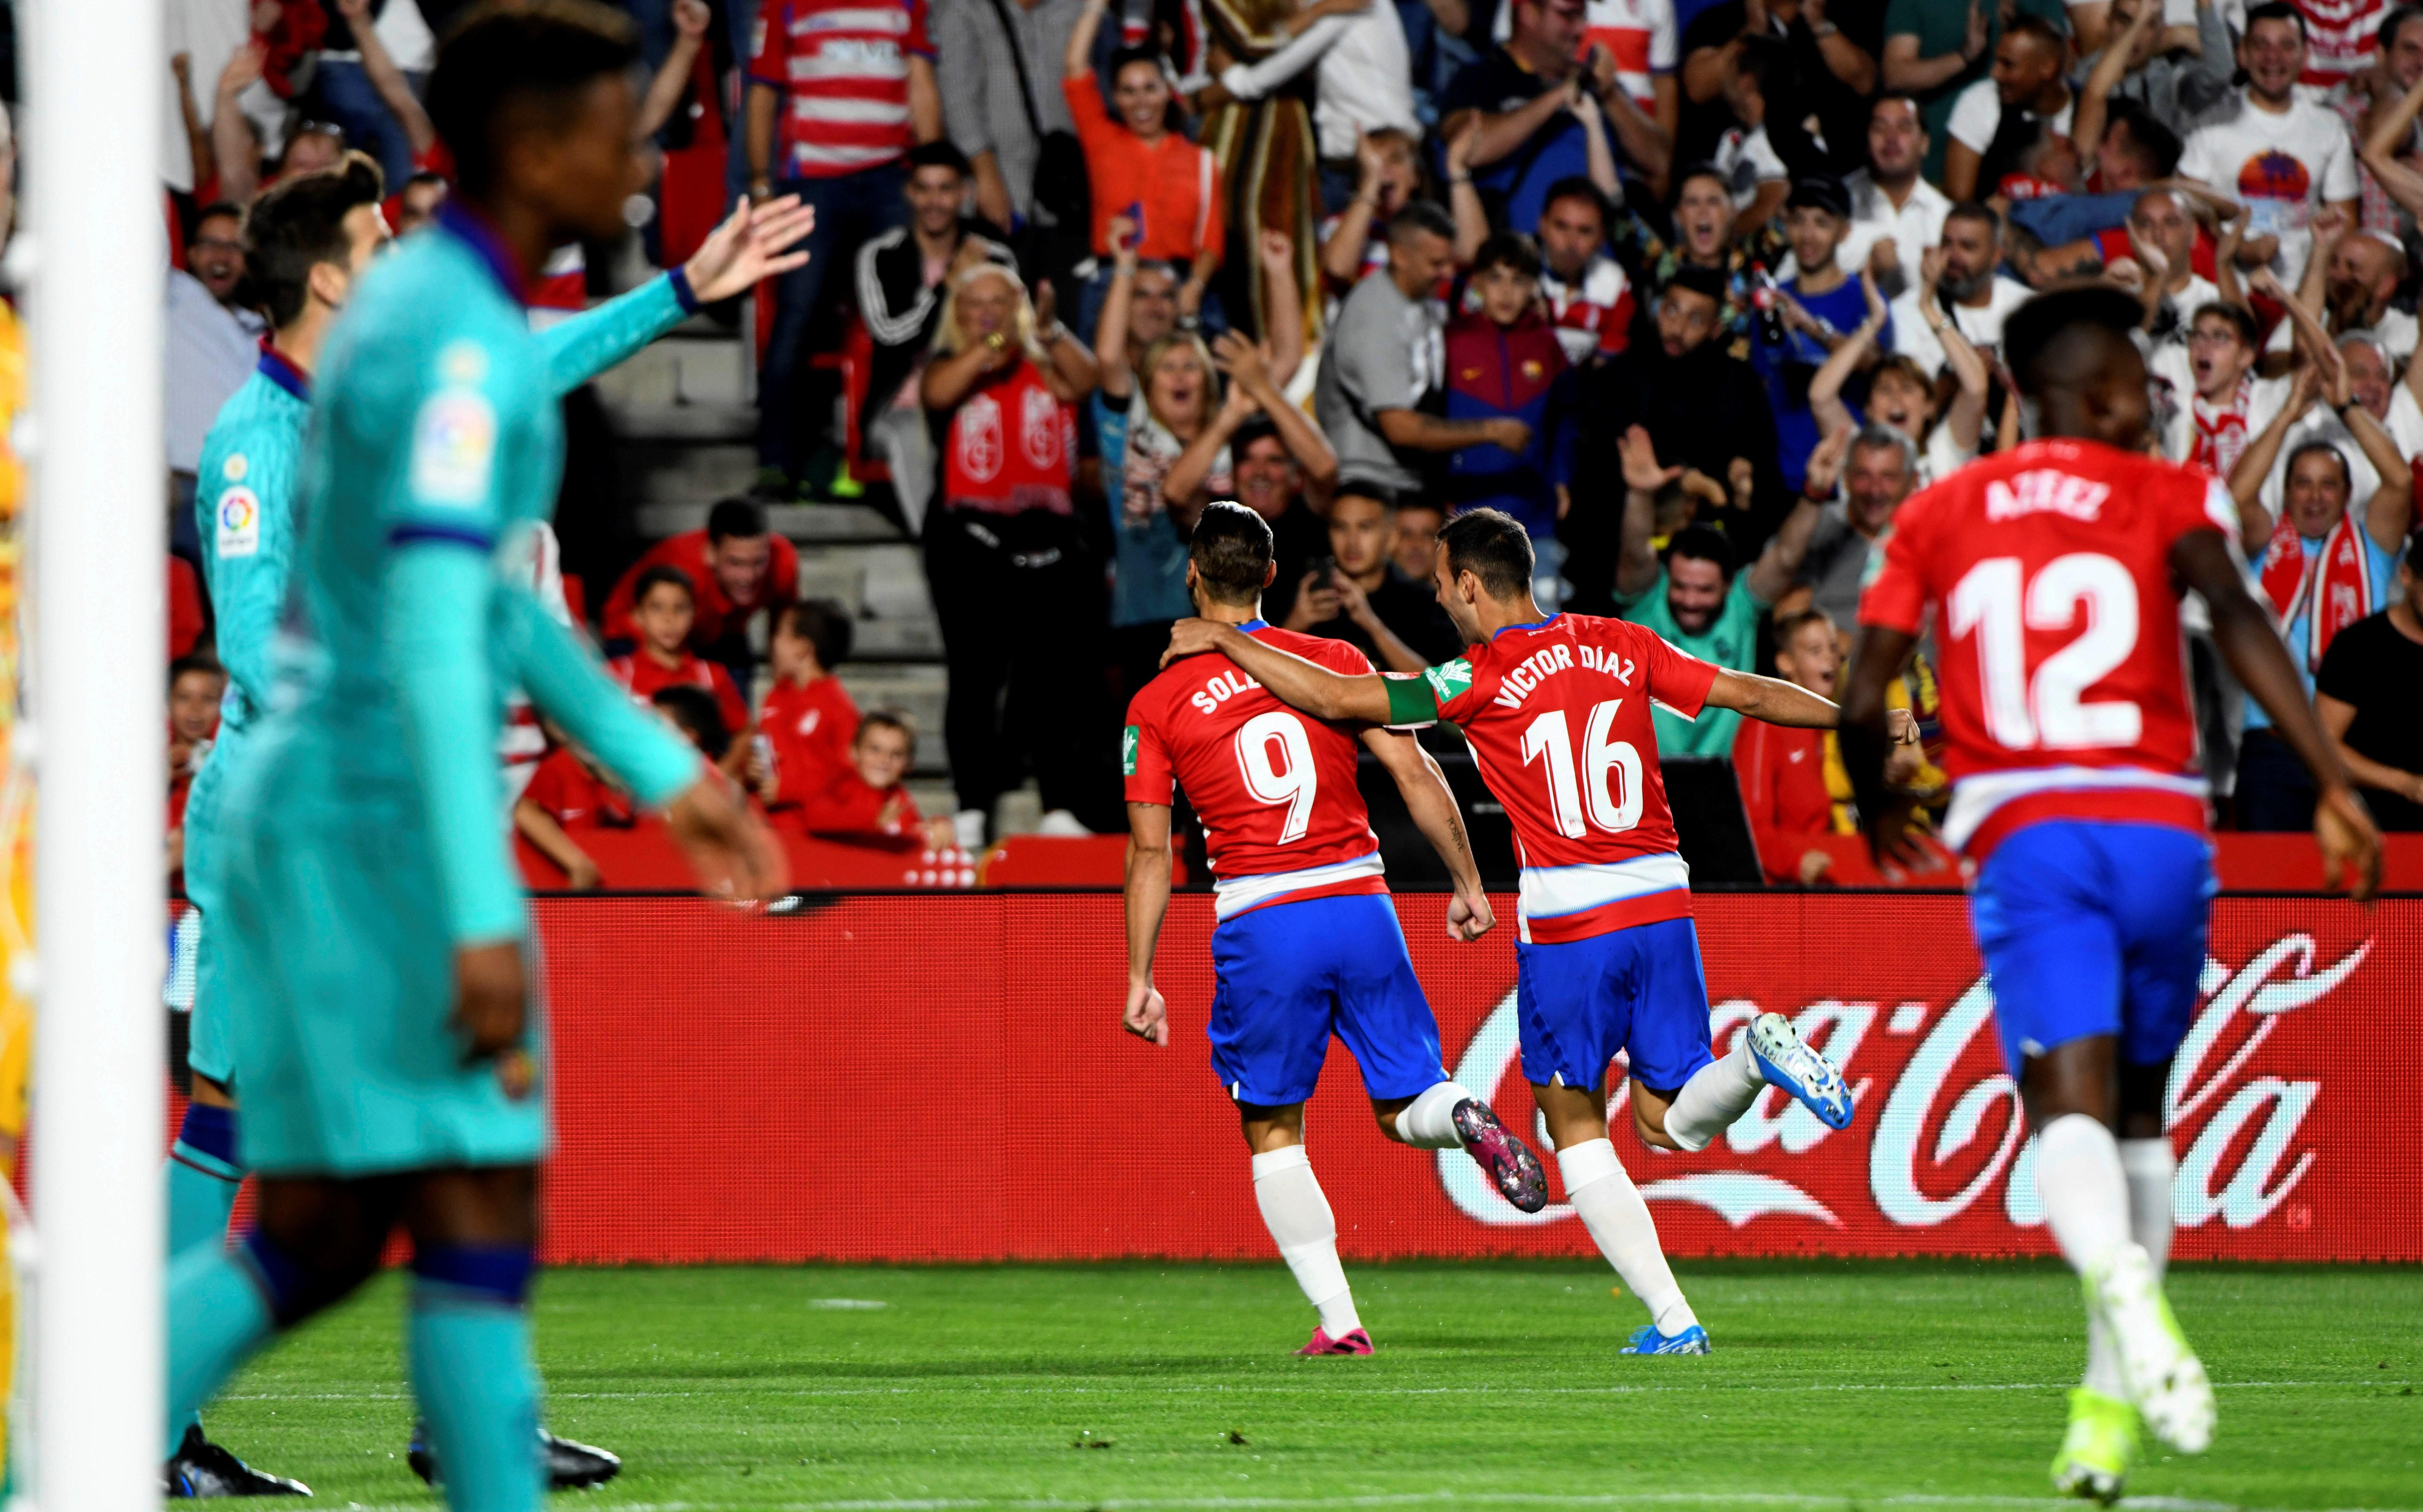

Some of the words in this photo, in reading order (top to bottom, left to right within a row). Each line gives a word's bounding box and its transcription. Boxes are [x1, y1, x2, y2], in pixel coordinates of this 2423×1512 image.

[1493, 644, 1574, 709] VÍCTOR
[1578, 645, 1635, 687] DÍAZ
[1947, 551, 2143, 751] 12
[1235, 711, 1317, 846] 9
[1520, 698, 1643, 839] 16
